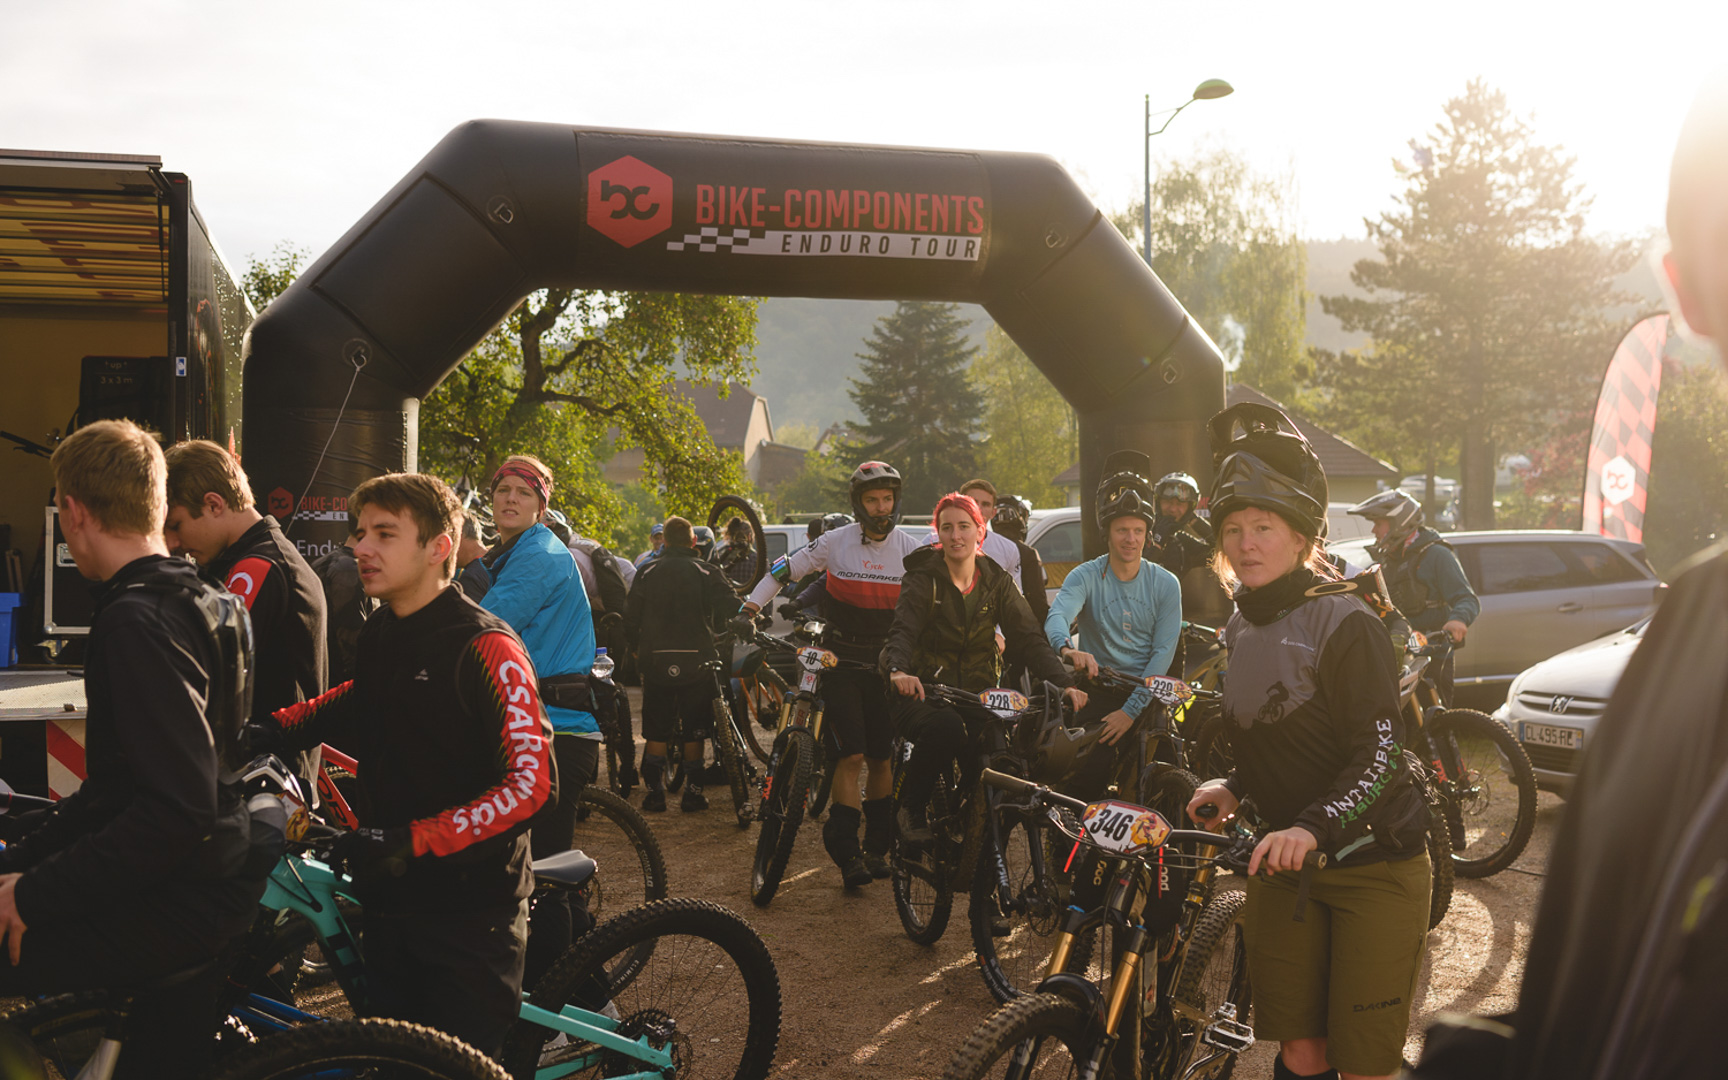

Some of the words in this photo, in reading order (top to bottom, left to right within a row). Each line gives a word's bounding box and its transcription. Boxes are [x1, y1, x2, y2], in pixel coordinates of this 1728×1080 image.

[696, 184, 985, 235] BIKE-COMPONENTS
[781, 234, 890, 255] ENDURO
[910, 237, 977, 259] TOUR
[301, 496, 348, 511] BIKE-CO
[296, 539, 338, 557] End
[1122, 608, 1132, 642] FOX
[990, 694, 1010, 710] 228
[1089, 808, 1134, 842] 346
